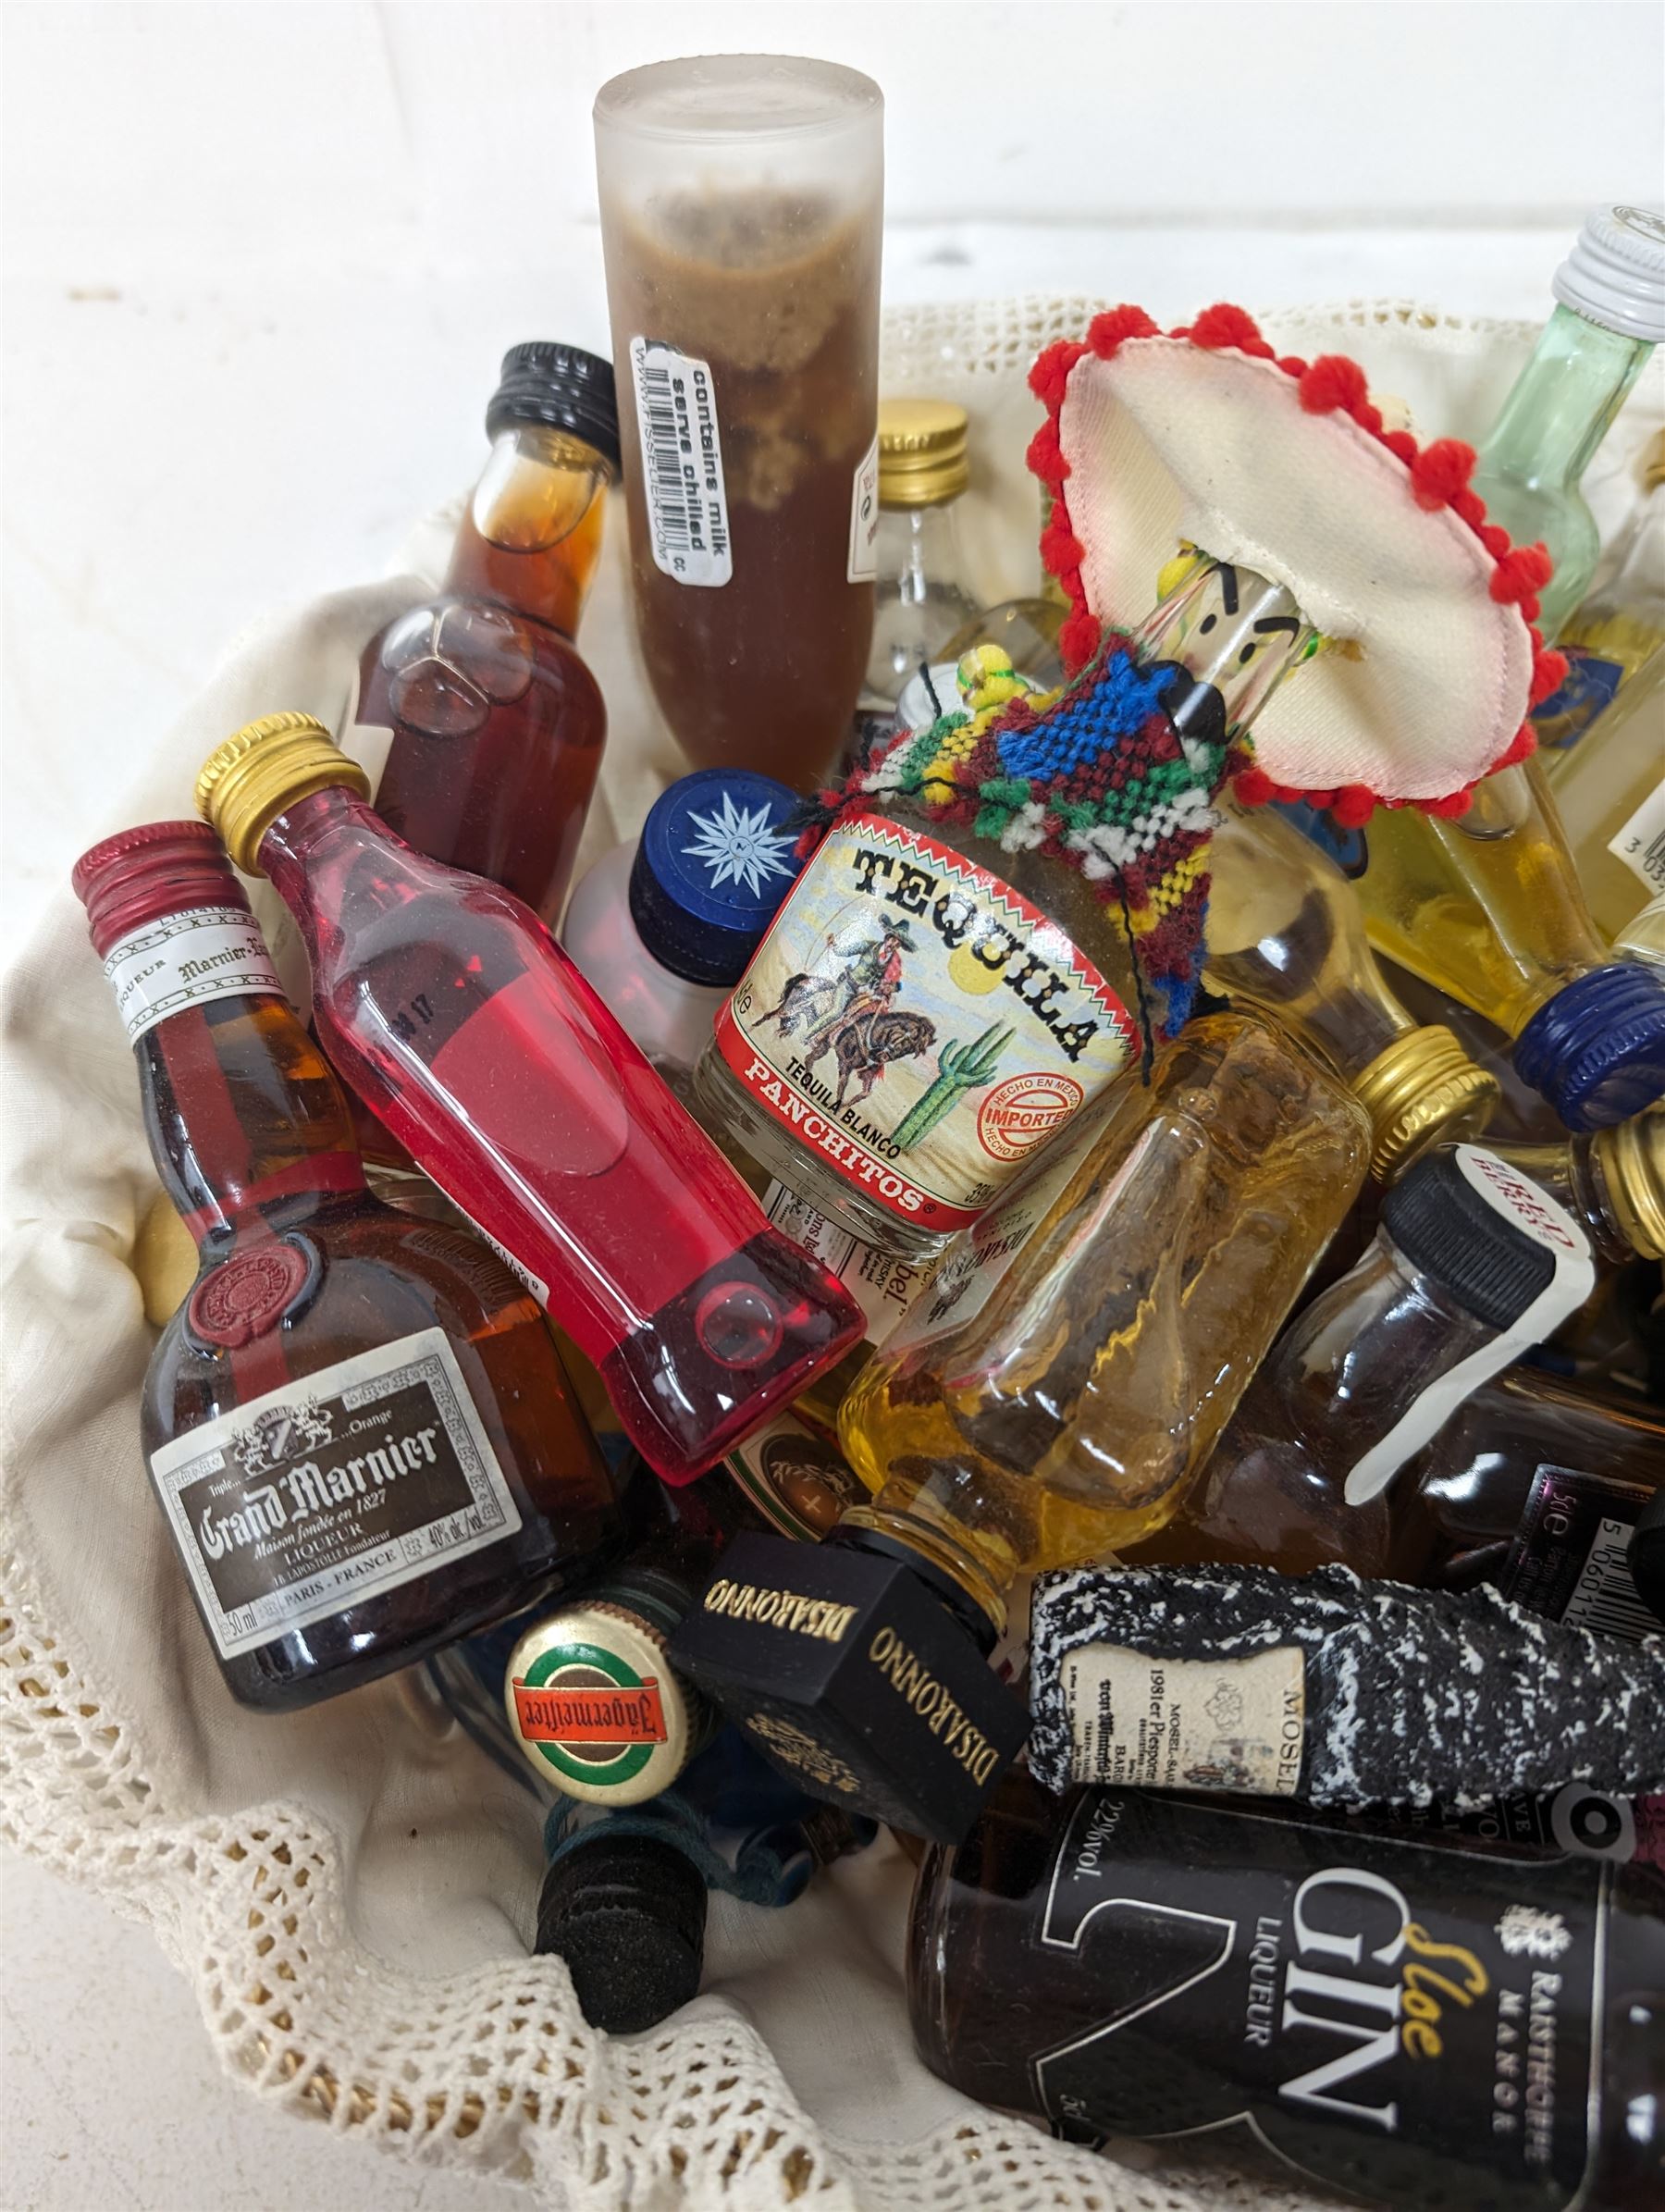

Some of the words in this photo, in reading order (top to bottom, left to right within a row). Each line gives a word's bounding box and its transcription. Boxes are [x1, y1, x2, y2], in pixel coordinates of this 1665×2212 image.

[672, 377, 693, 455] serve
[683, 464, 707, 552] chilled
[693, 370, 719, 492] contains
[708, 501, 727, 557] milk
[1623, 836, 1642, 853] 3
[852, 846, 1100, 1064] TEQUILA
[784, 1056, 844, 1116] TEQUILA
[840, 1107, 903, 1160] BLANCO
[985, 1107, 1075, 1128] IMPORTED
[993, 1079, 1033, 1107] HECHO
[1036, 1078, 1054, 1087] EN
[1054, 1081, 1080, 1107] MEXICO
[744, 1057, 924, 1212] PANCHITOS
[985, 1127, 1011, 1155] HECHO
[1011, 1148, 1027, 1157] EN
[1502, 1180, 1576, 1249] RED
[874, 1258, 894, 1290] HISKY
[199, 1482, 289, 1561] Grand
[278, 1427, 438, 1525] Marnier
[253, 1529, 296, 1562] Maison
[337, 1510, 353, 1524] en
[355, 1489, 387, 1516] 1827
[283, 1523, 365, 1566] LIQUEUR
[342, 1529, 392, 1558] Fondateur
[428, 1520, 451, 1549] 40%
[1602, 1520, 1622, 1536] 5
[284, 1581, 325, 1607] PARIS
[334, 1549, 398, 1585] FRANCE
[703, 1578, 861, 1643] DISARONNO
[242, 1609, 257, 1631] ml
[869, 1625, 1000, 1786] DISARONNO
[1149, 1668, 1166, 1720] 1981er
[1146, 1721, 1166, 1781] Piesporter
[1244, 1914, 1285, 2048] LIQUEUR
[1276, 1865, 1412, 2133] GIN
[1400, 1922, 1490, 2061] Sloe
[1491, 1988, 1526, 2134] MANOR
